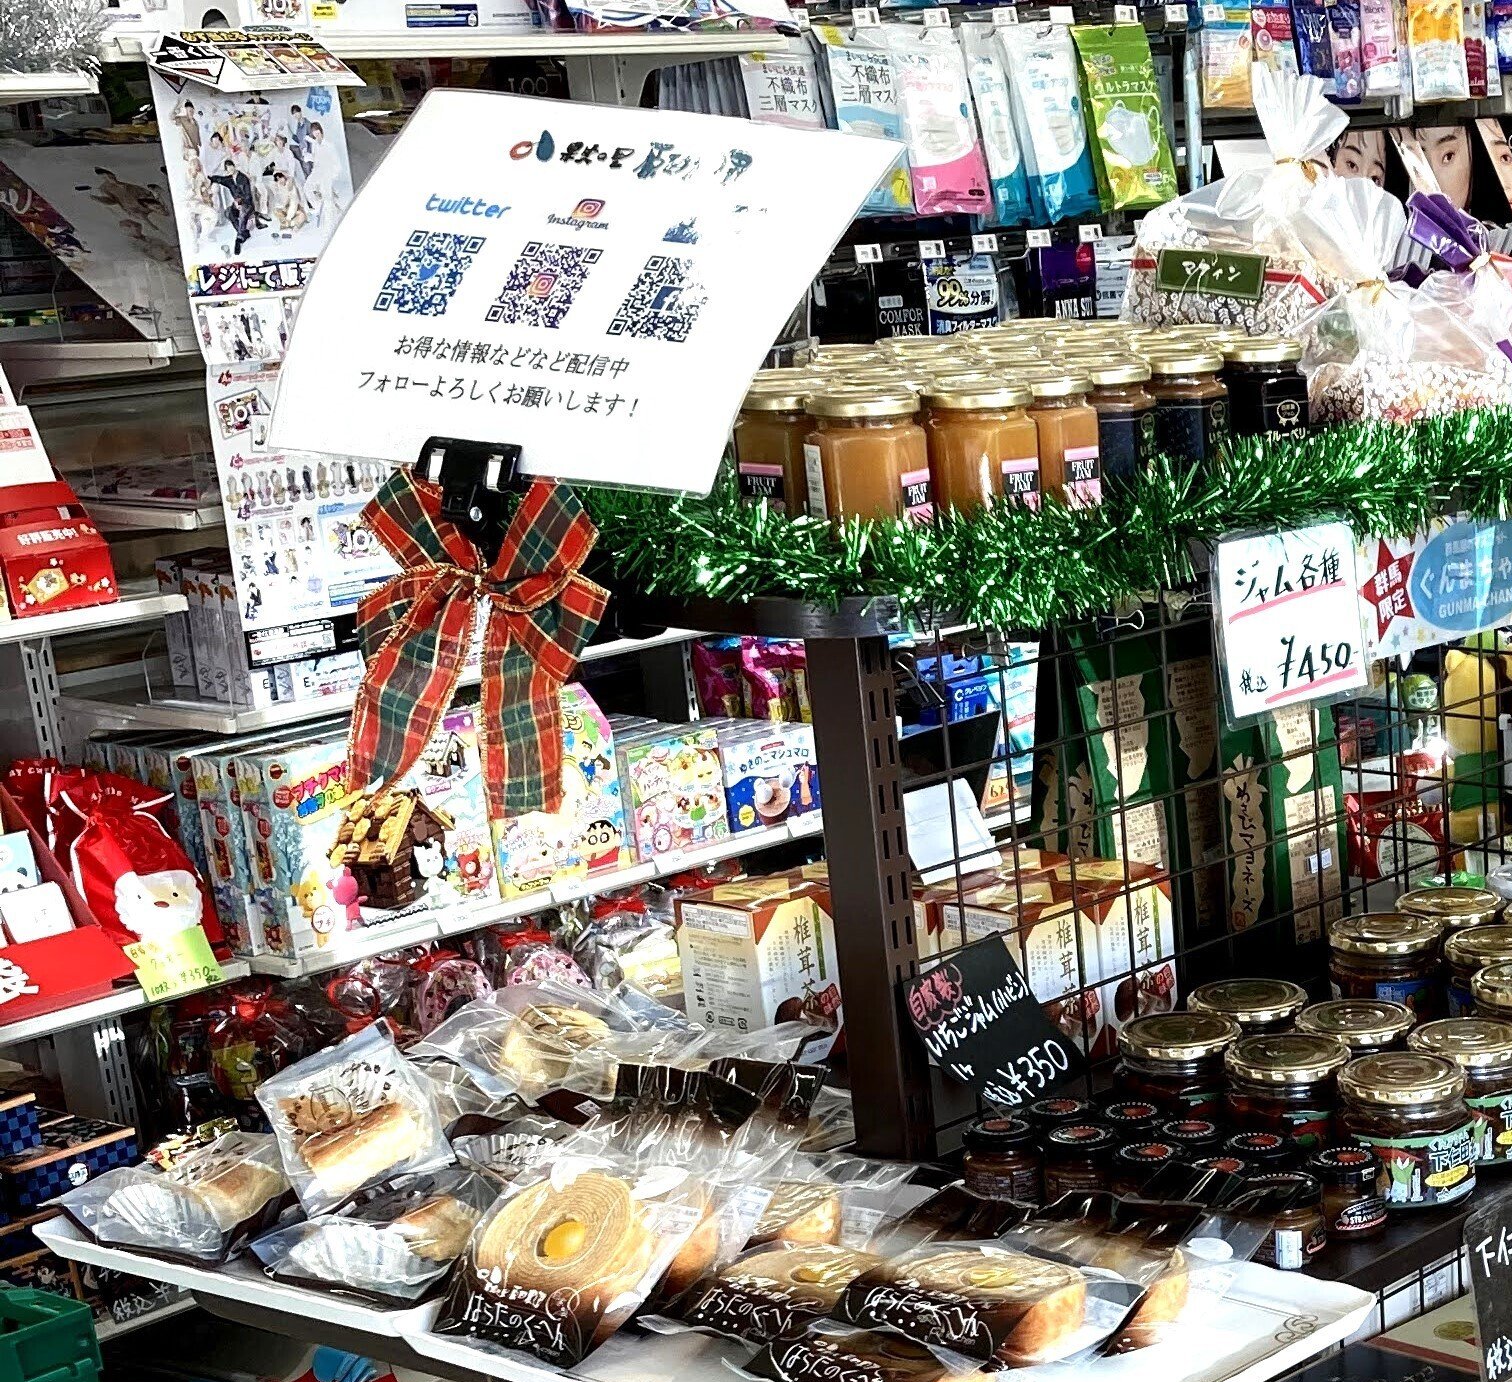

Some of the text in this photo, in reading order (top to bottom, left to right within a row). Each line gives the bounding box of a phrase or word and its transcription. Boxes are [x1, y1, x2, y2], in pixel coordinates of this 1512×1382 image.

[851, 64, 891, 85] 不織布
[426, 194, 512, 220] twitter
[547, 213, 609, 230] Instagram
[395, 335, 630, 378] お得な情報などなど配信中
[1235, 547, 1343, 606] ジャム各種
[1373, 562, 1402, 596] 群馬
[1377, 590, 1406, 624] 限定
[793, 914, 817, 1010] 椎茸茶
[996, 1038, 1069, 1099] ¥350
